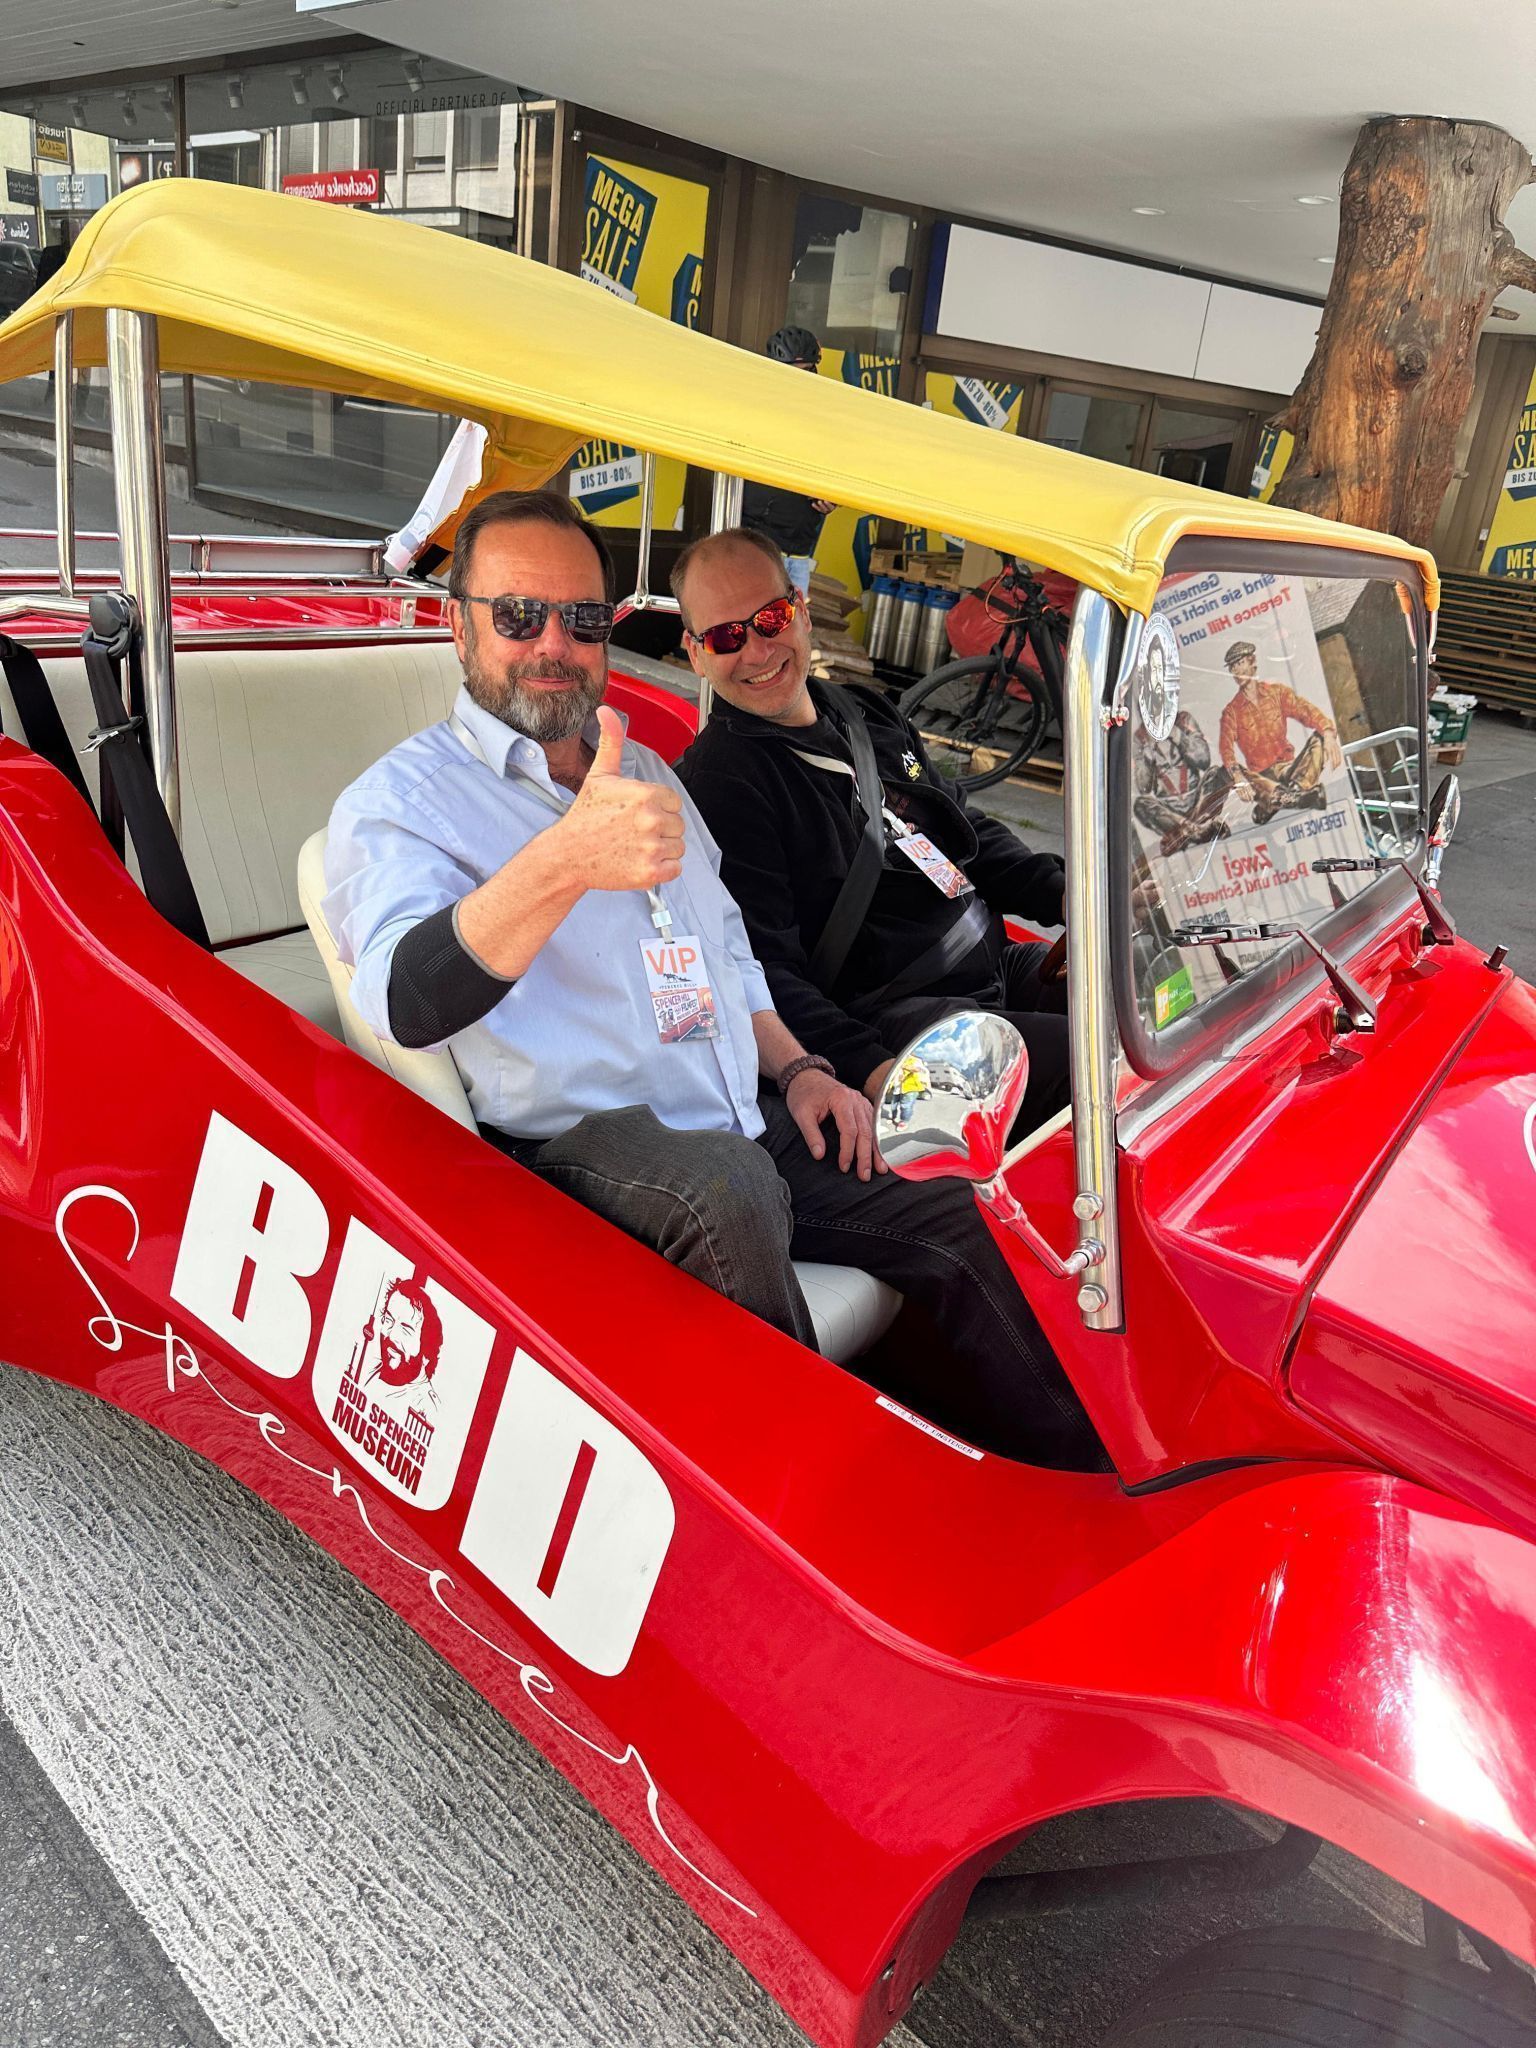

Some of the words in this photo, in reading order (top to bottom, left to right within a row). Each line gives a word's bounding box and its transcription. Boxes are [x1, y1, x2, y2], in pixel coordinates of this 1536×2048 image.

[376, 99, 426, 115] OFFICIAL
[432, 94, 486, 110] PARTNER
[491, 92, 507, 106] OF
[591, 169, 646, 238] MEGA
[581, 206, 638, 283] SALE
[962, 377, 977, 391] BIS
[972, 386, 983, 402] ZU
[580, 473, 595, 490] BIS
[597, 470, 608, 486] ZU
[610, 465, 632, 482] -80%
[1511, 472, 1526, 484] BIS
[903, 841, 932, 858] VIP
[645, 947, 697, 975] VIP
[171, 1109, 676, 1677] BUD
[339, 1376, 368, 1413] BUD
[369, 1402, 428, 1467] SPENCER
[908, 1414, 929, 1430] NICHT
[331, 1396, 422, 1496] MUSEUM
[55, 1185, 757, 1918] Spencer
